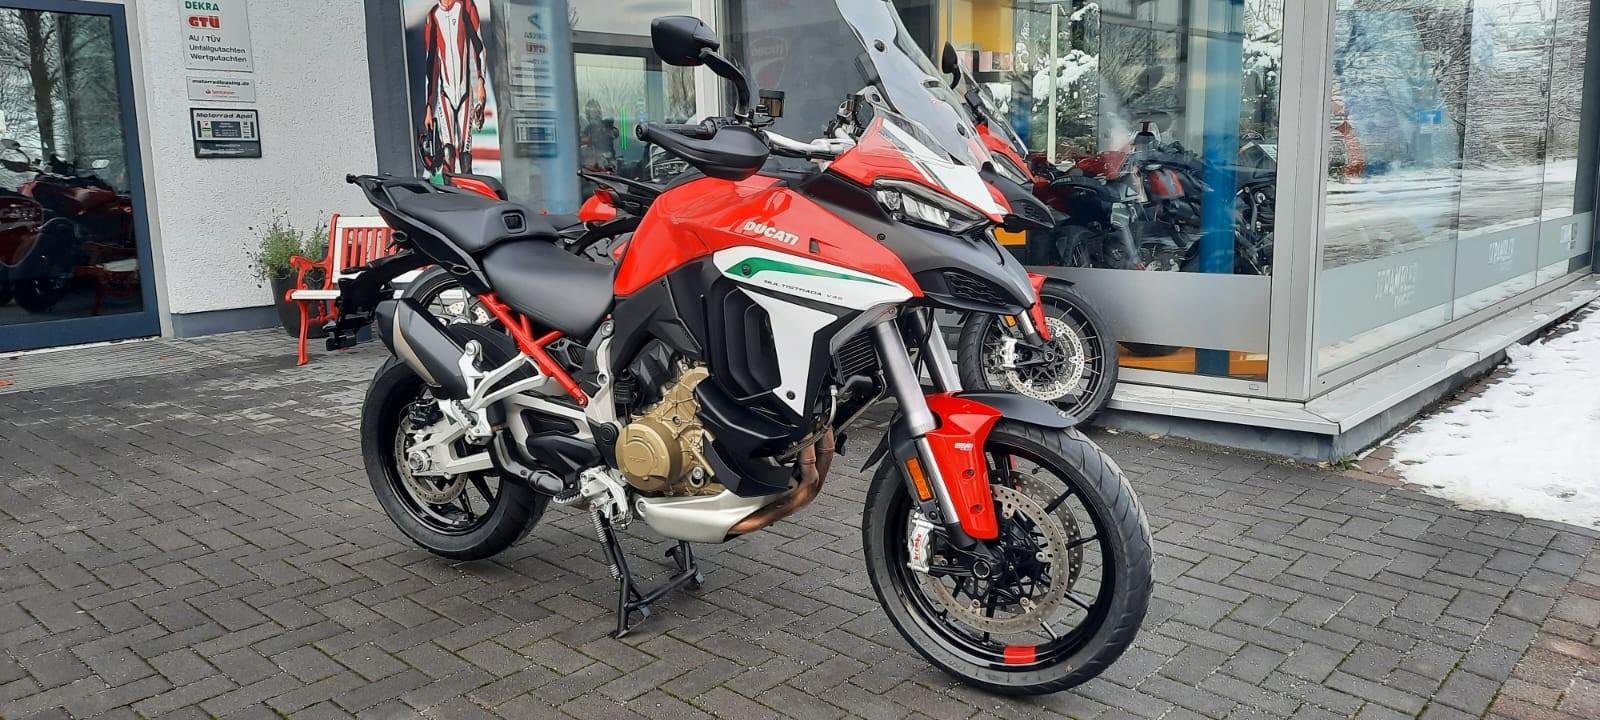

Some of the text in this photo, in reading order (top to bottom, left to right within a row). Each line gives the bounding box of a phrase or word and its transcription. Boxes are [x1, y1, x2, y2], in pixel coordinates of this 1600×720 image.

[185, 0, 220, 11] DEKRA
[188, 15, 220, 28] GTÜ
[189, 34, 199, 42] AU
[206, 34, 221, 43] TÜV
[189, 44, 246, 54] Unfallgutachten
[190, 53, 247, 63] Wertgutachten
[743, 220, 800, 246] DUCATI
[763, 279, 822, 296] MULTISTRADA
